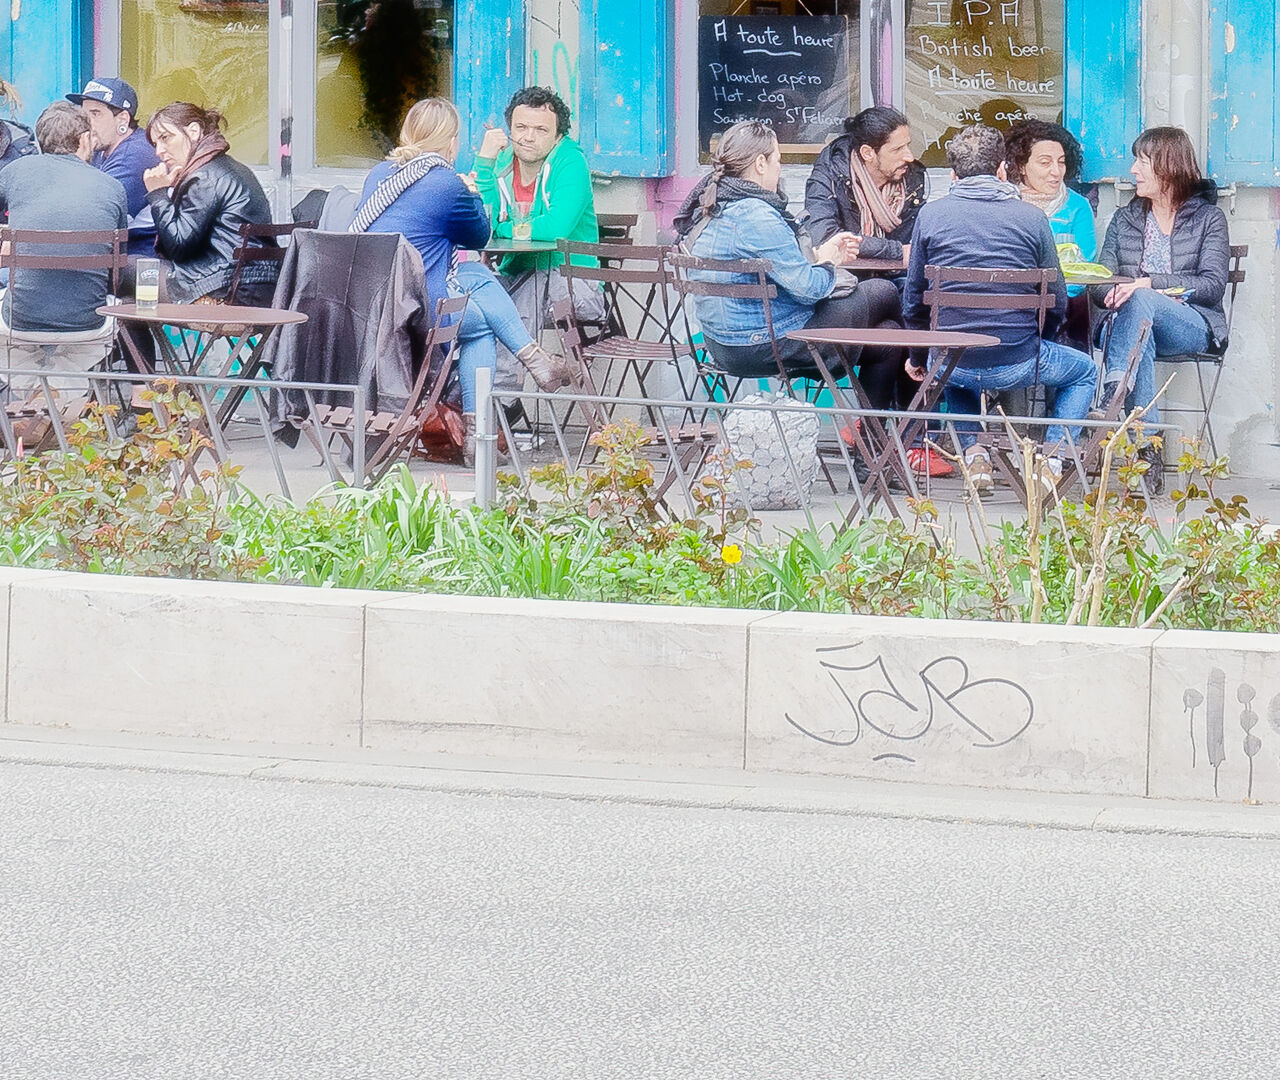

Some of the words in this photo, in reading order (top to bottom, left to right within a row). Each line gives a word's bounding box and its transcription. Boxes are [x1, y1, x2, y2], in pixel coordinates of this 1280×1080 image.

[736, 23, 783, 46] toute
[793, 25, 834, 48] heure
[919, 34, 993, 57] British
[1008, 36, 1052, 57] beer
[708, 62, 770, 84] Planche
[777, 71, 822, 90] apéro
[949, 68, 997, 90] toute
[1007, 70, 1055, 93] heure
[713, 86, 744, 102] Hot
[757, 88, 787, 110] dog
